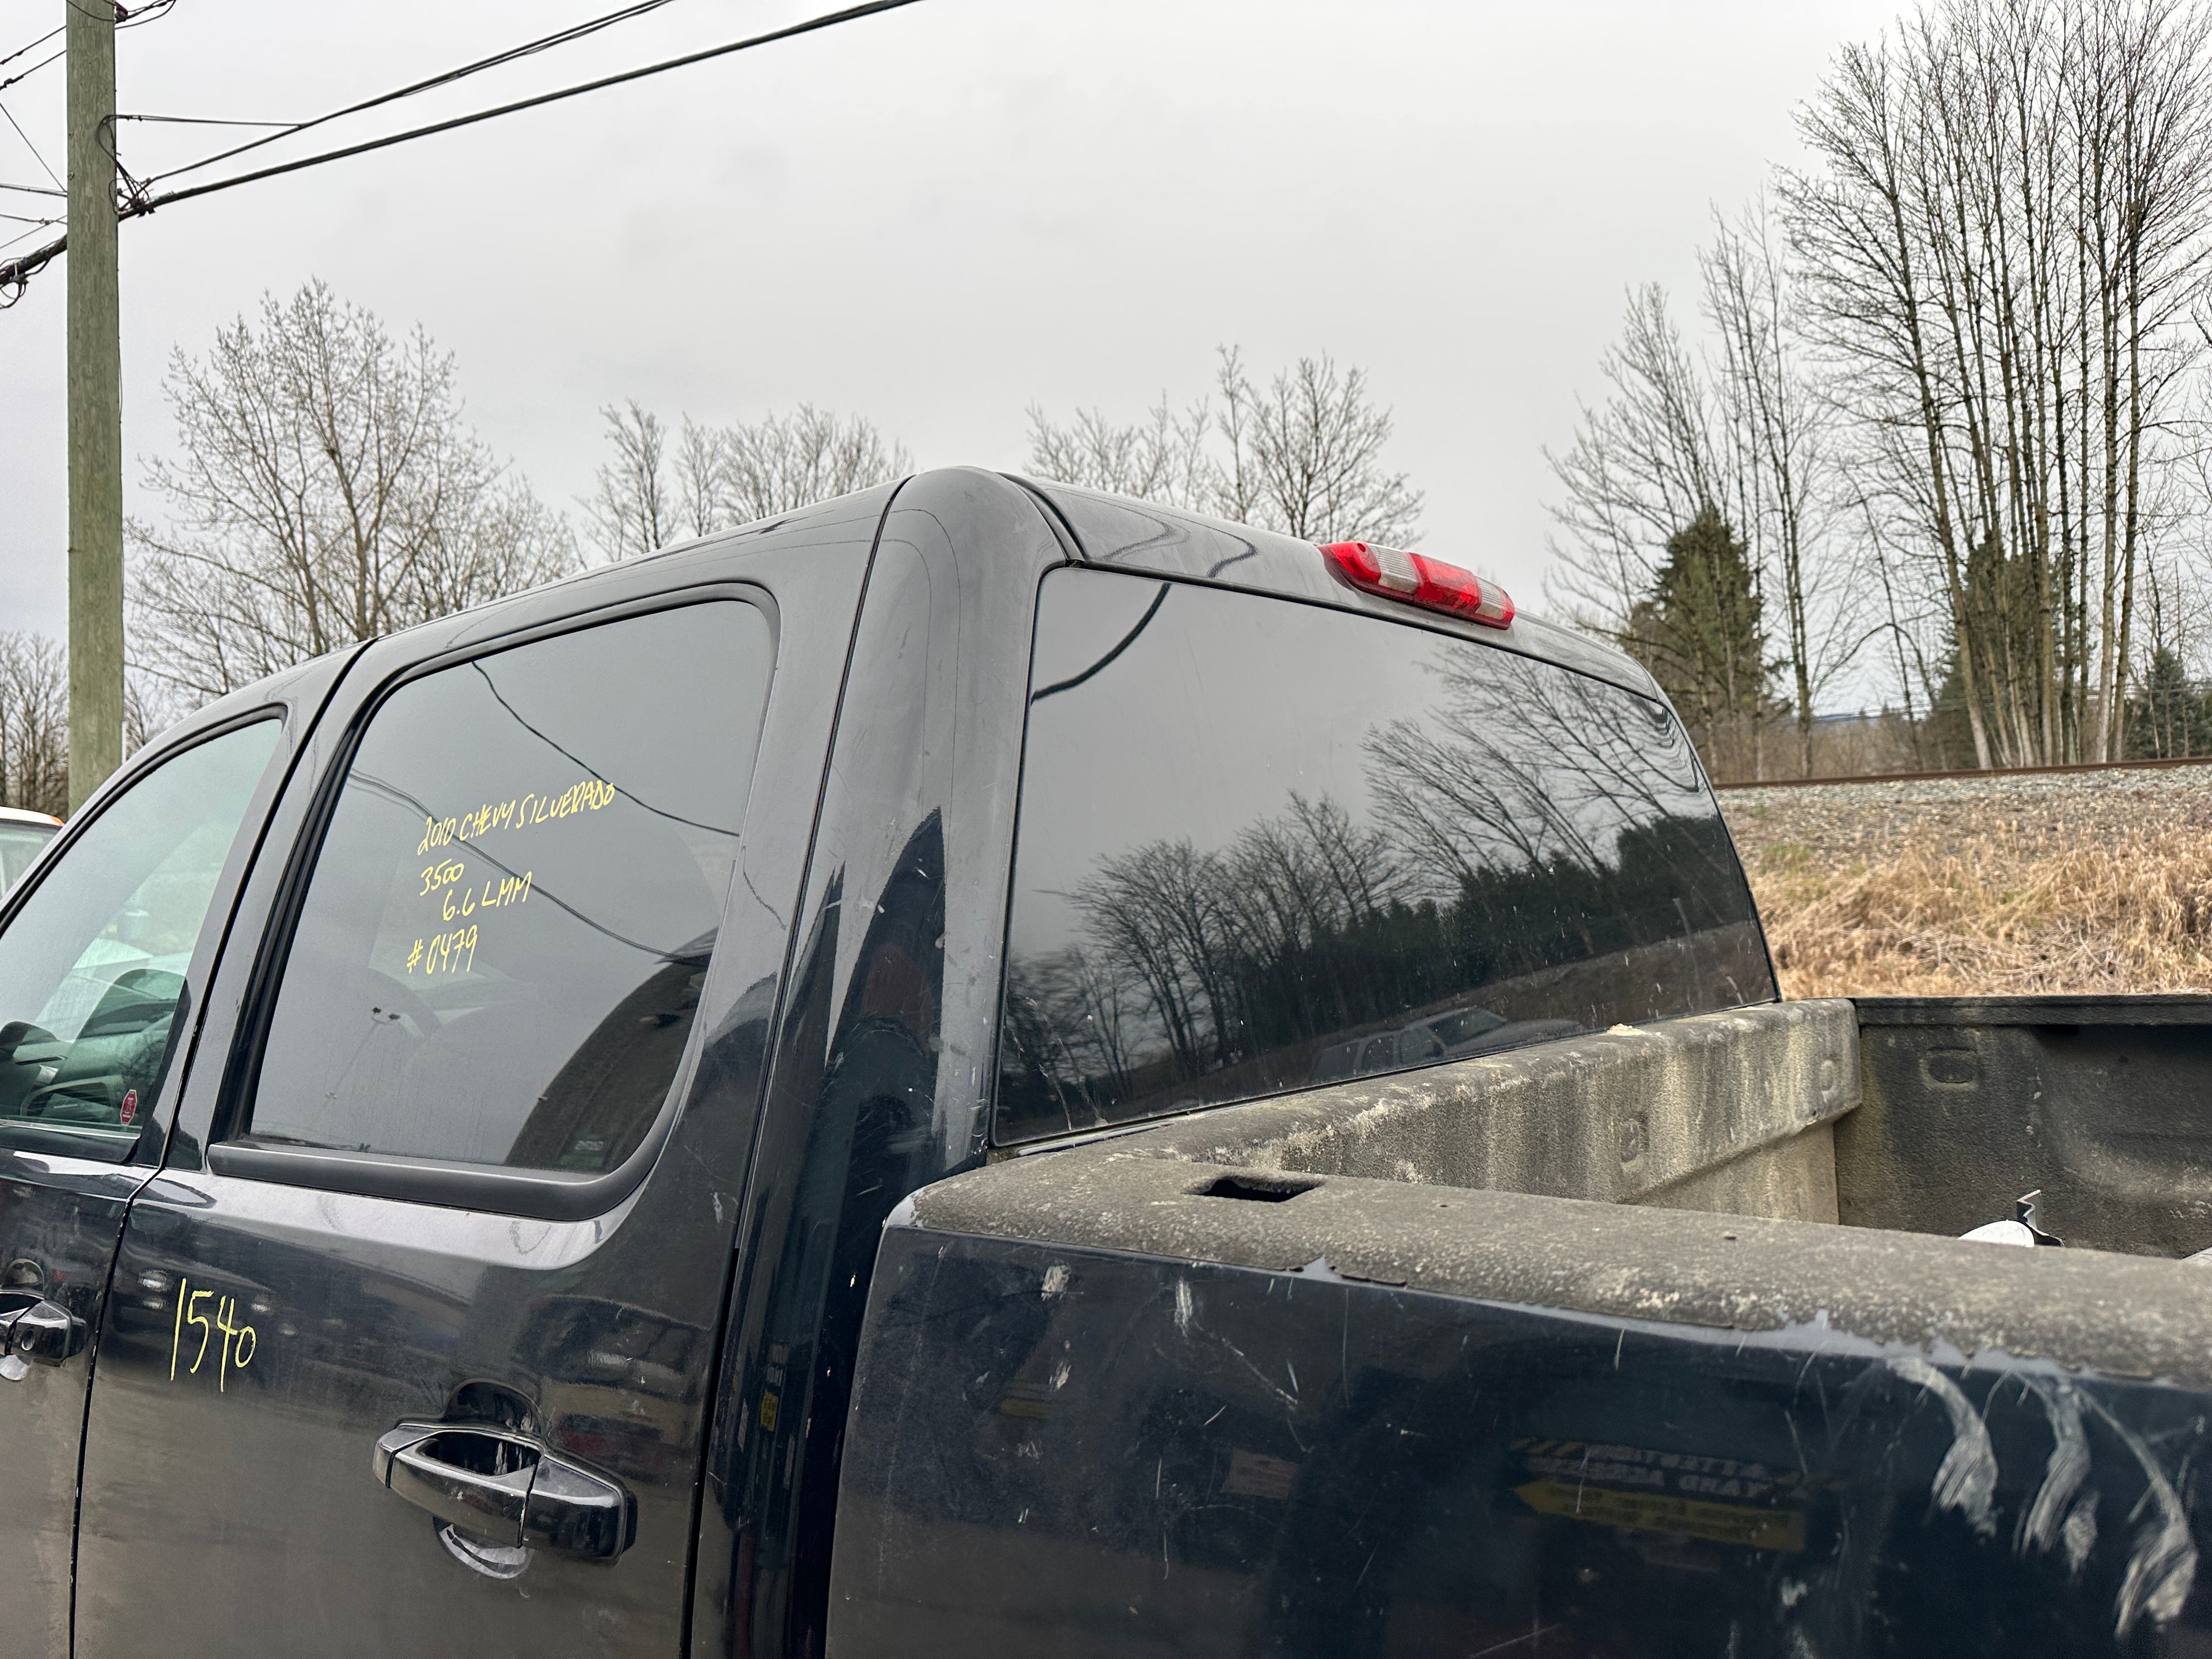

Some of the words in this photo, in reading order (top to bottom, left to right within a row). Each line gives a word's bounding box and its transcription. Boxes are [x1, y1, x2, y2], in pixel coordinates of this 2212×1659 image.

[417, 816, 456, 855] 2010
[459, 799, 516, 841] CHEVY
[516, 779, 615, 829] SILVERADO
[419, 858, 464, 896] 3500
[442, 889, 475, 922] 6.6
[481, 871, 532, 907] LMM
[170, 1277, 257, 1393] 1540
